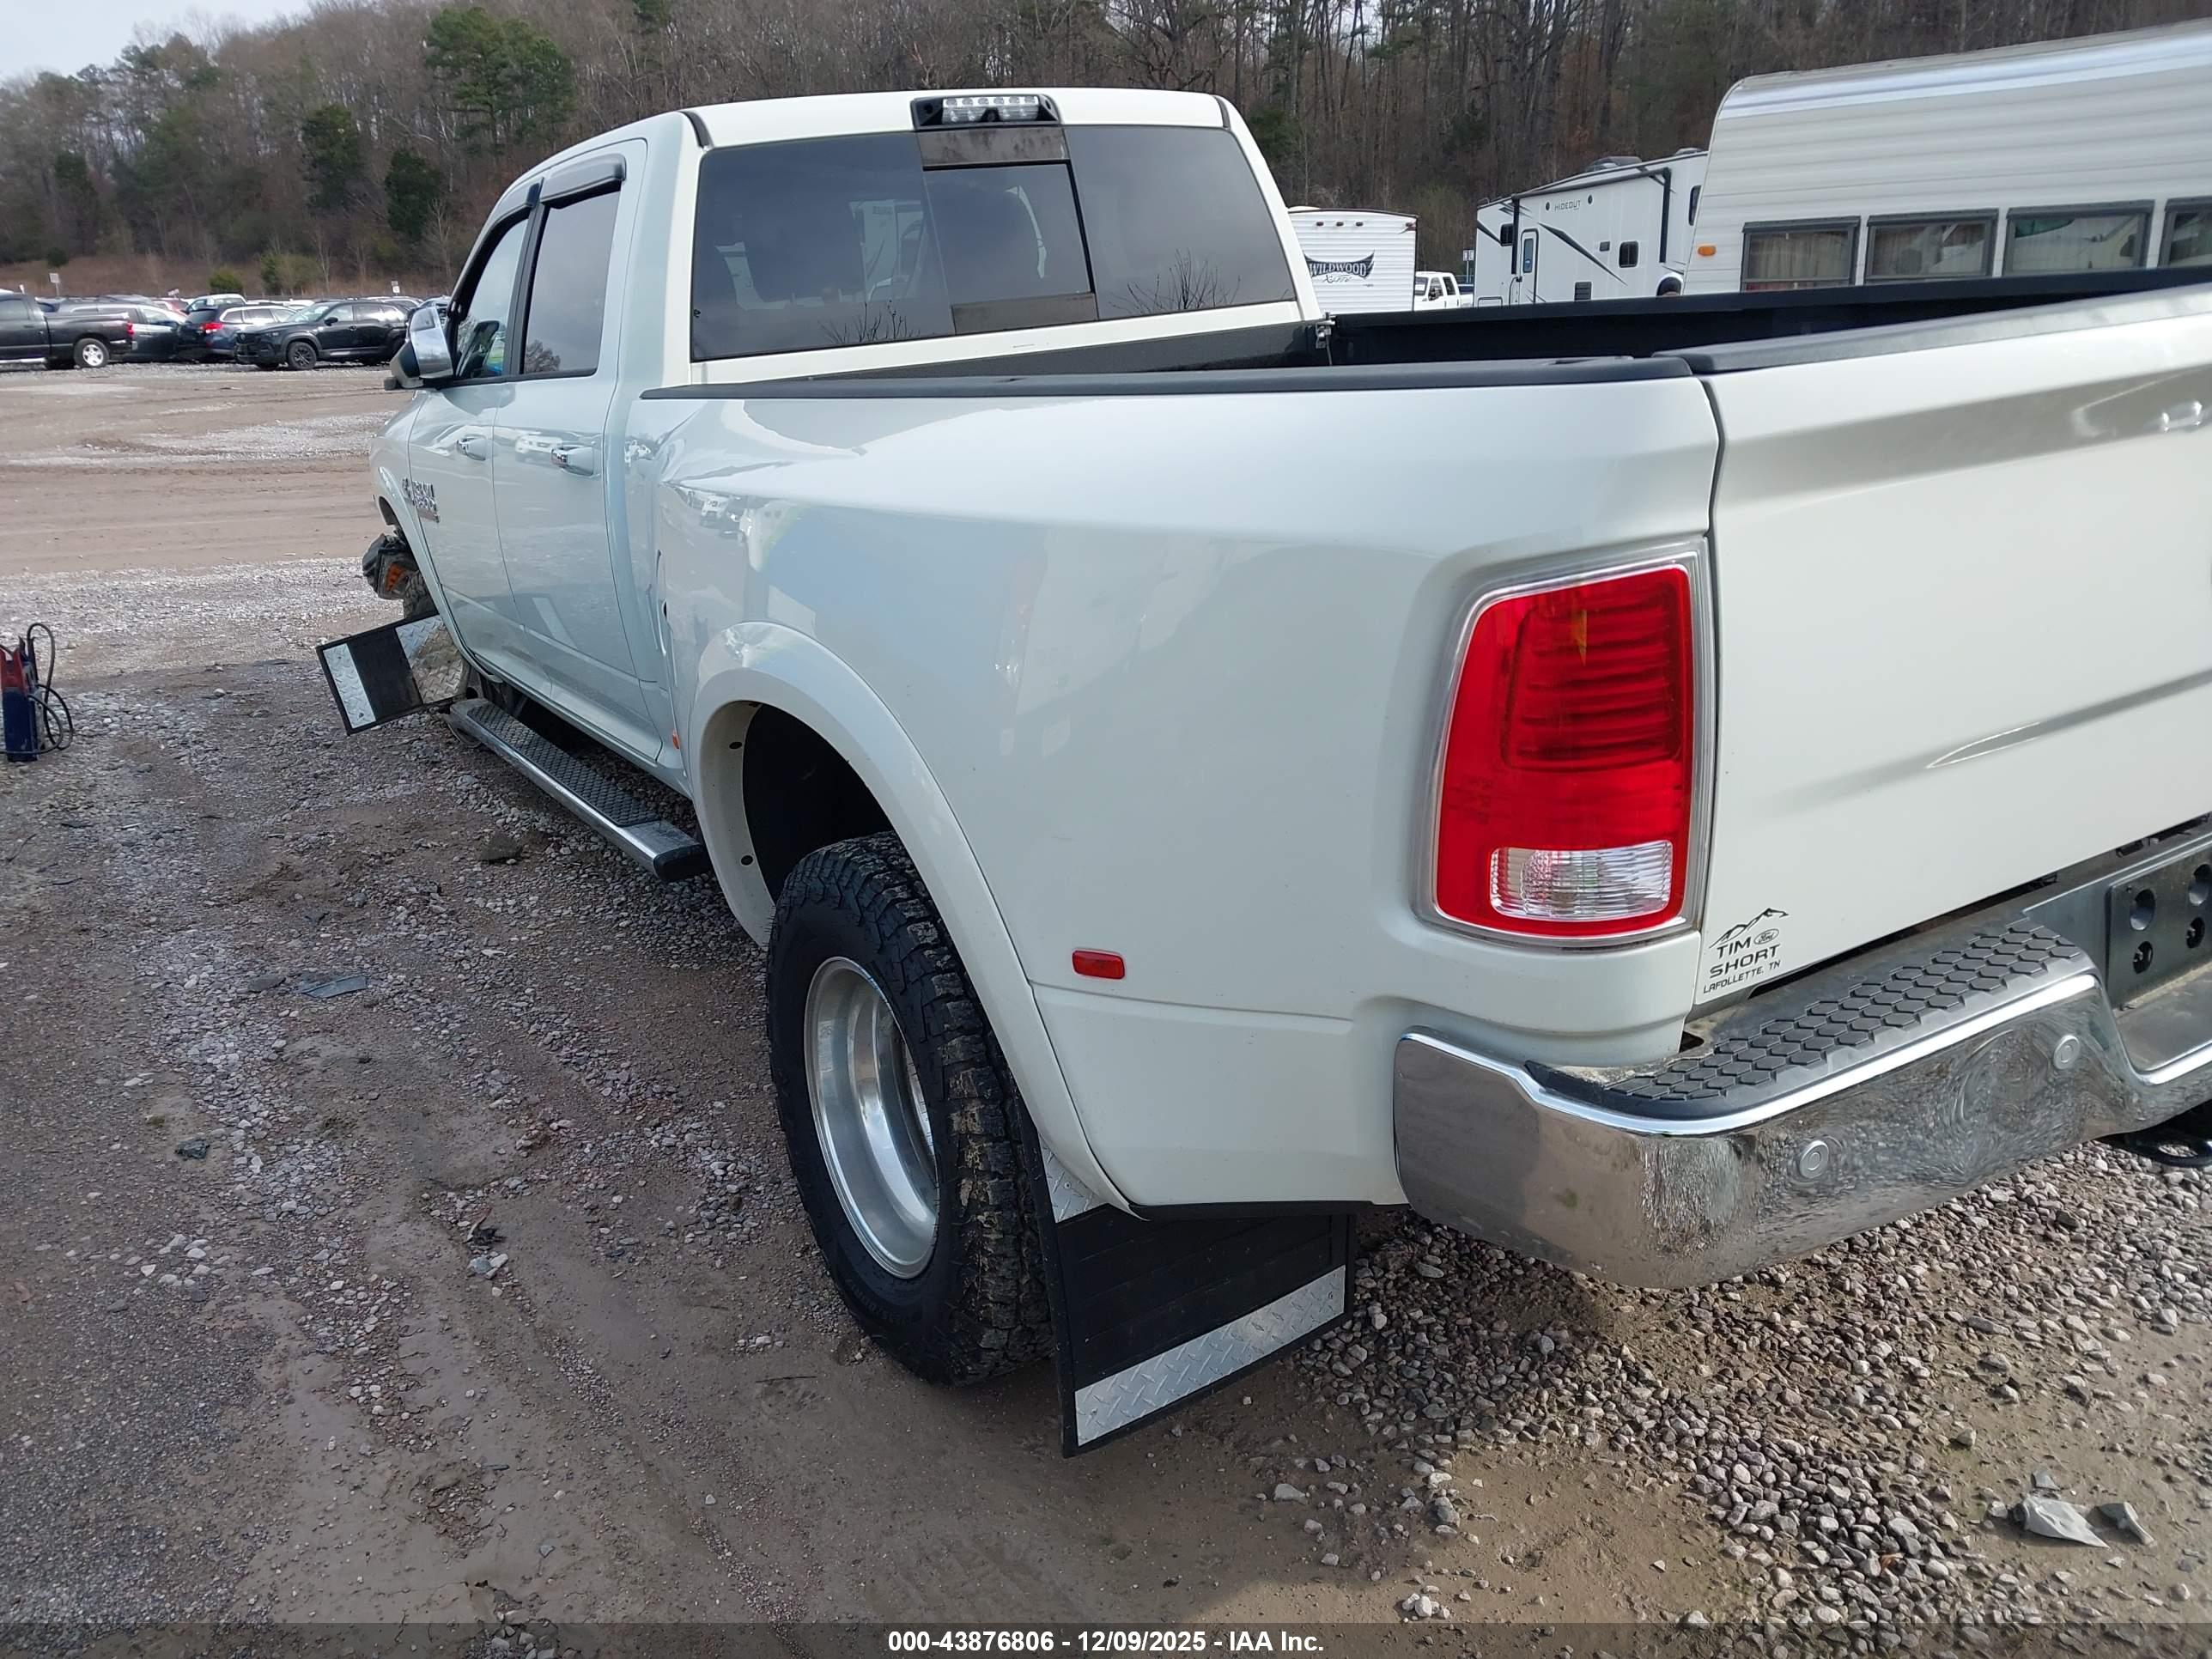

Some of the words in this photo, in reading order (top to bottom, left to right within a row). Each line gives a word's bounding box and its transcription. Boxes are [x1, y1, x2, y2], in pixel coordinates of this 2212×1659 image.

[1554, 200, 1580, 210] HIDEOUT
[1310, 263, 1366, 276] WILDWOOD
[1717, 937, 1752, 959] TIM
[1710, 944, 1781, 978] SHORT
[1769, 959, 1781, 970] TN
